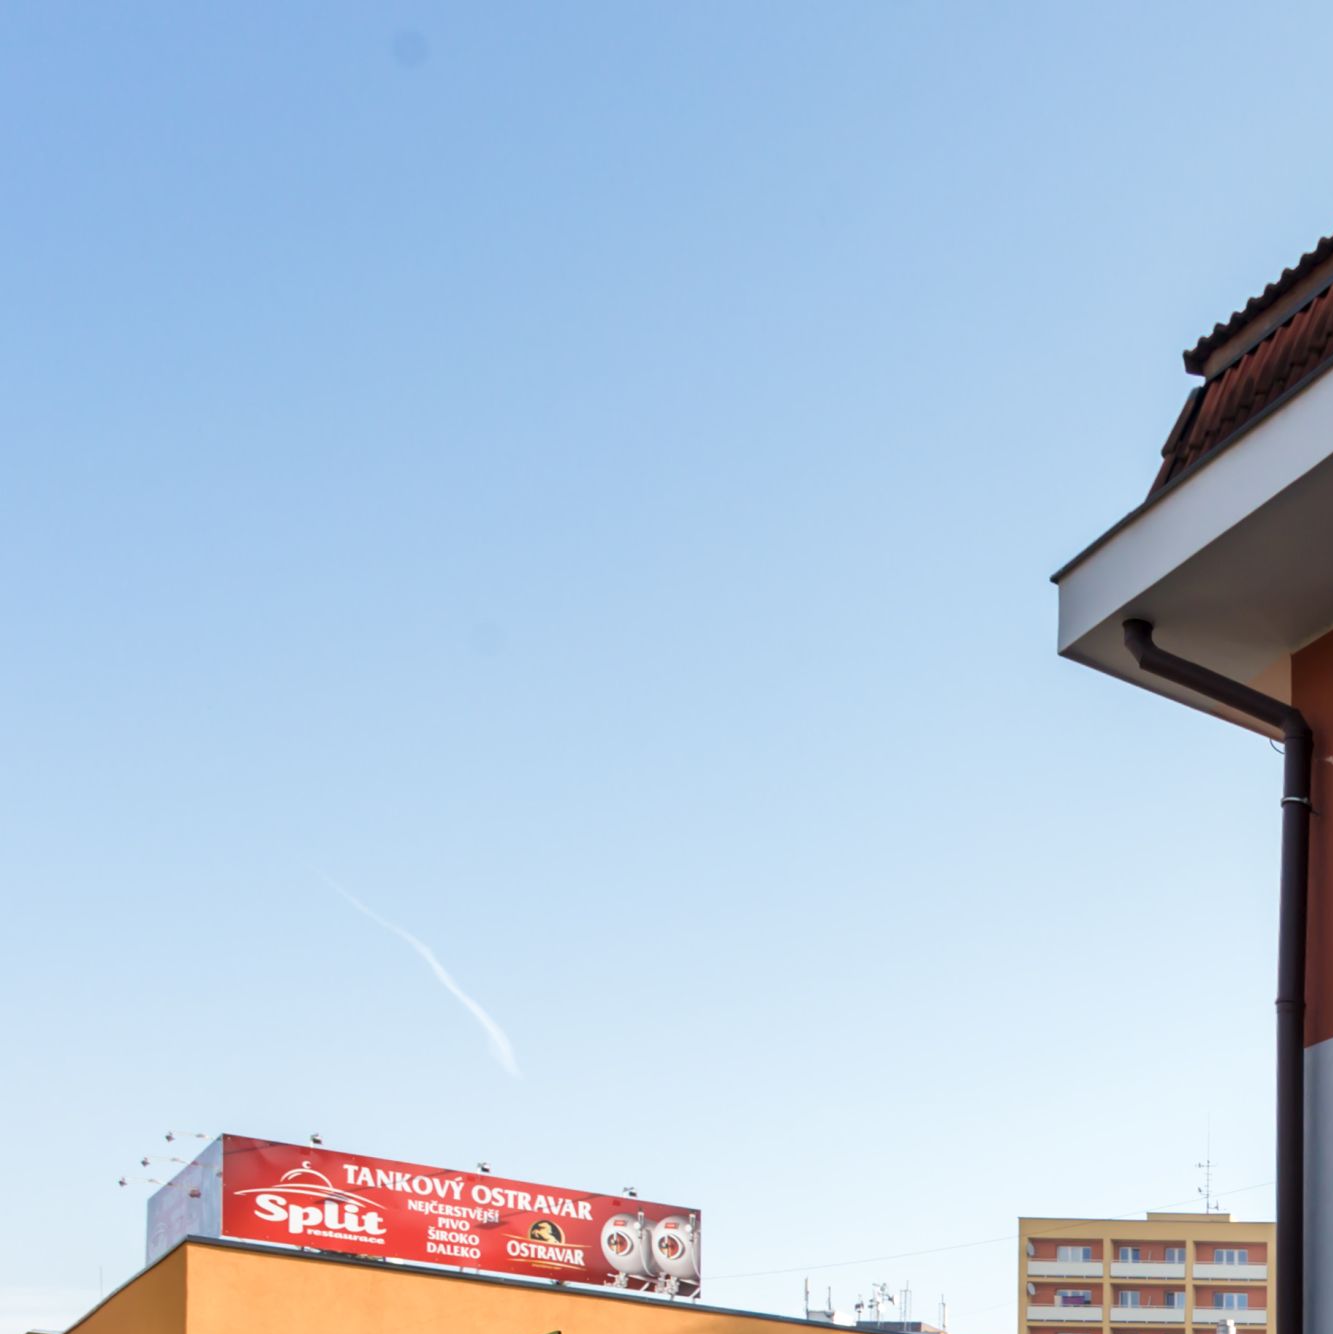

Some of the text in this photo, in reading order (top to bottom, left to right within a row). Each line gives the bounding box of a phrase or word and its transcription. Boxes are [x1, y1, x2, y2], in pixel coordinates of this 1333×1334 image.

[343, 1164, 592, 1221] TANKOVÝ OSTRAVAR
[254, 1194, 387, 1235] Split
[408, 1199, 500, 1223] NEJČERSTVĚJŠÍ
[437, 1217, 470, 1231] PIVO
[307, 1228, 386, 1245] restaurace
[428, 1226, 480, 1246] ŠIROKO
[426, 1242, 481, 1259] DALEKO
[506, 1240, 585, 1266] OSTRAVAR
